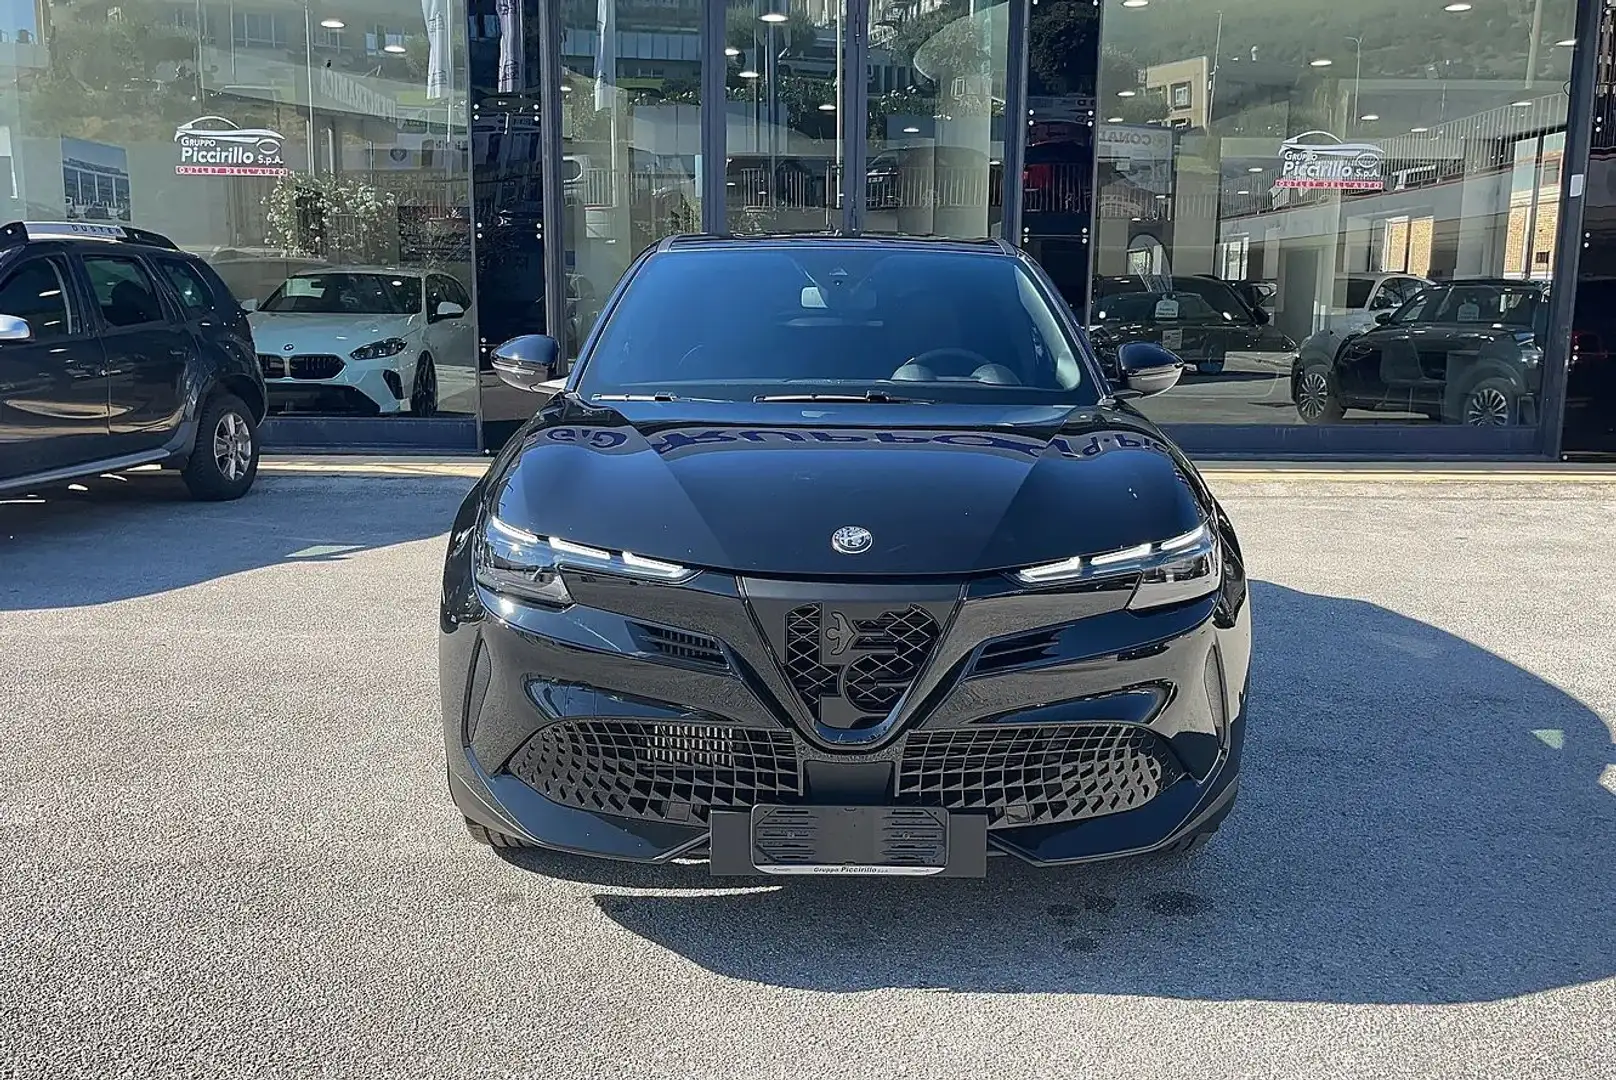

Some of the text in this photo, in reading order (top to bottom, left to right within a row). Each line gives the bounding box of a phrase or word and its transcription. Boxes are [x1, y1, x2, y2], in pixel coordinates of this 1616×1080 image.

[181, 137, 216, 147] GRUPPO
[181, 147, 254, 164] Piccirillo
[71, 225, 121, 234] DUSTER
